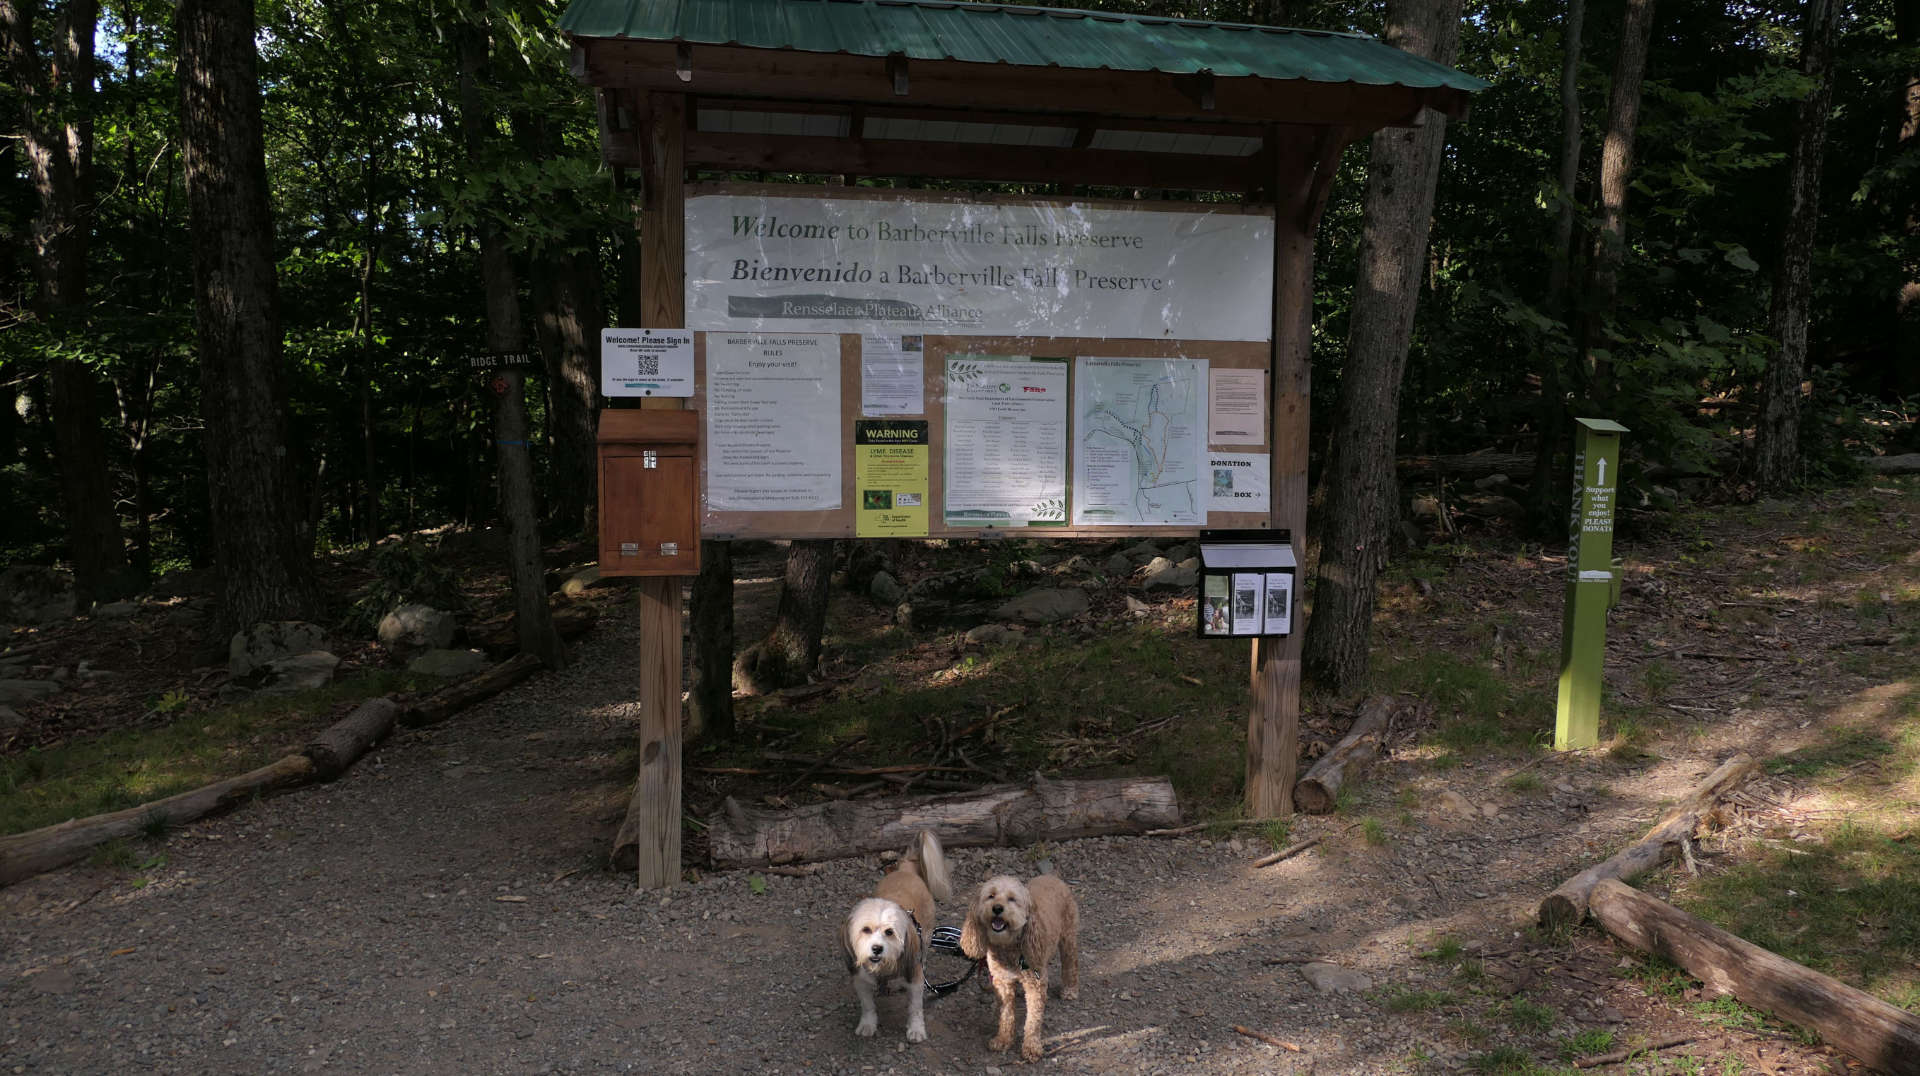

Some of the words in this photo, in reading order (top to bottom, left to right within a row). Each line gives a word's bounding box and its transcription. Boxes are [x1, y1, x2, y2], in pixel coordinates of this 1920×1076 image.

[731, 215, 840, 240] Welcome
[847, 225, 869, 241] to
[878, 221, 995, 246] Barberville
[1002, 223, 1048, 243] Falls
[1055, 225, 1144, 249] Preserve
[731, 258, 872, 283] Bienvenido
[879, 271, 889, 284] a
[897, 263, 1015, 287] Barberville
[1022, 267, 1068, 288] Fall
[1074, 269, 1162, 291] Preserve
[783, 301, 862, 317] Rensselaer
[925, 304, 984, 319] Alliance
[605, 335, 640, 344] Welcome!
[641, 336, 665, 344] Please
[666, 336, 682, 346] Sign
[470, 355, 498, 367] RIDGE
[503, 354, 531, 365] TRAIL
[865, 429, 919, 439] WARNING
[1210, 459, 1252, 467] DONATION
[1585, 486, 1615, 495] Support
